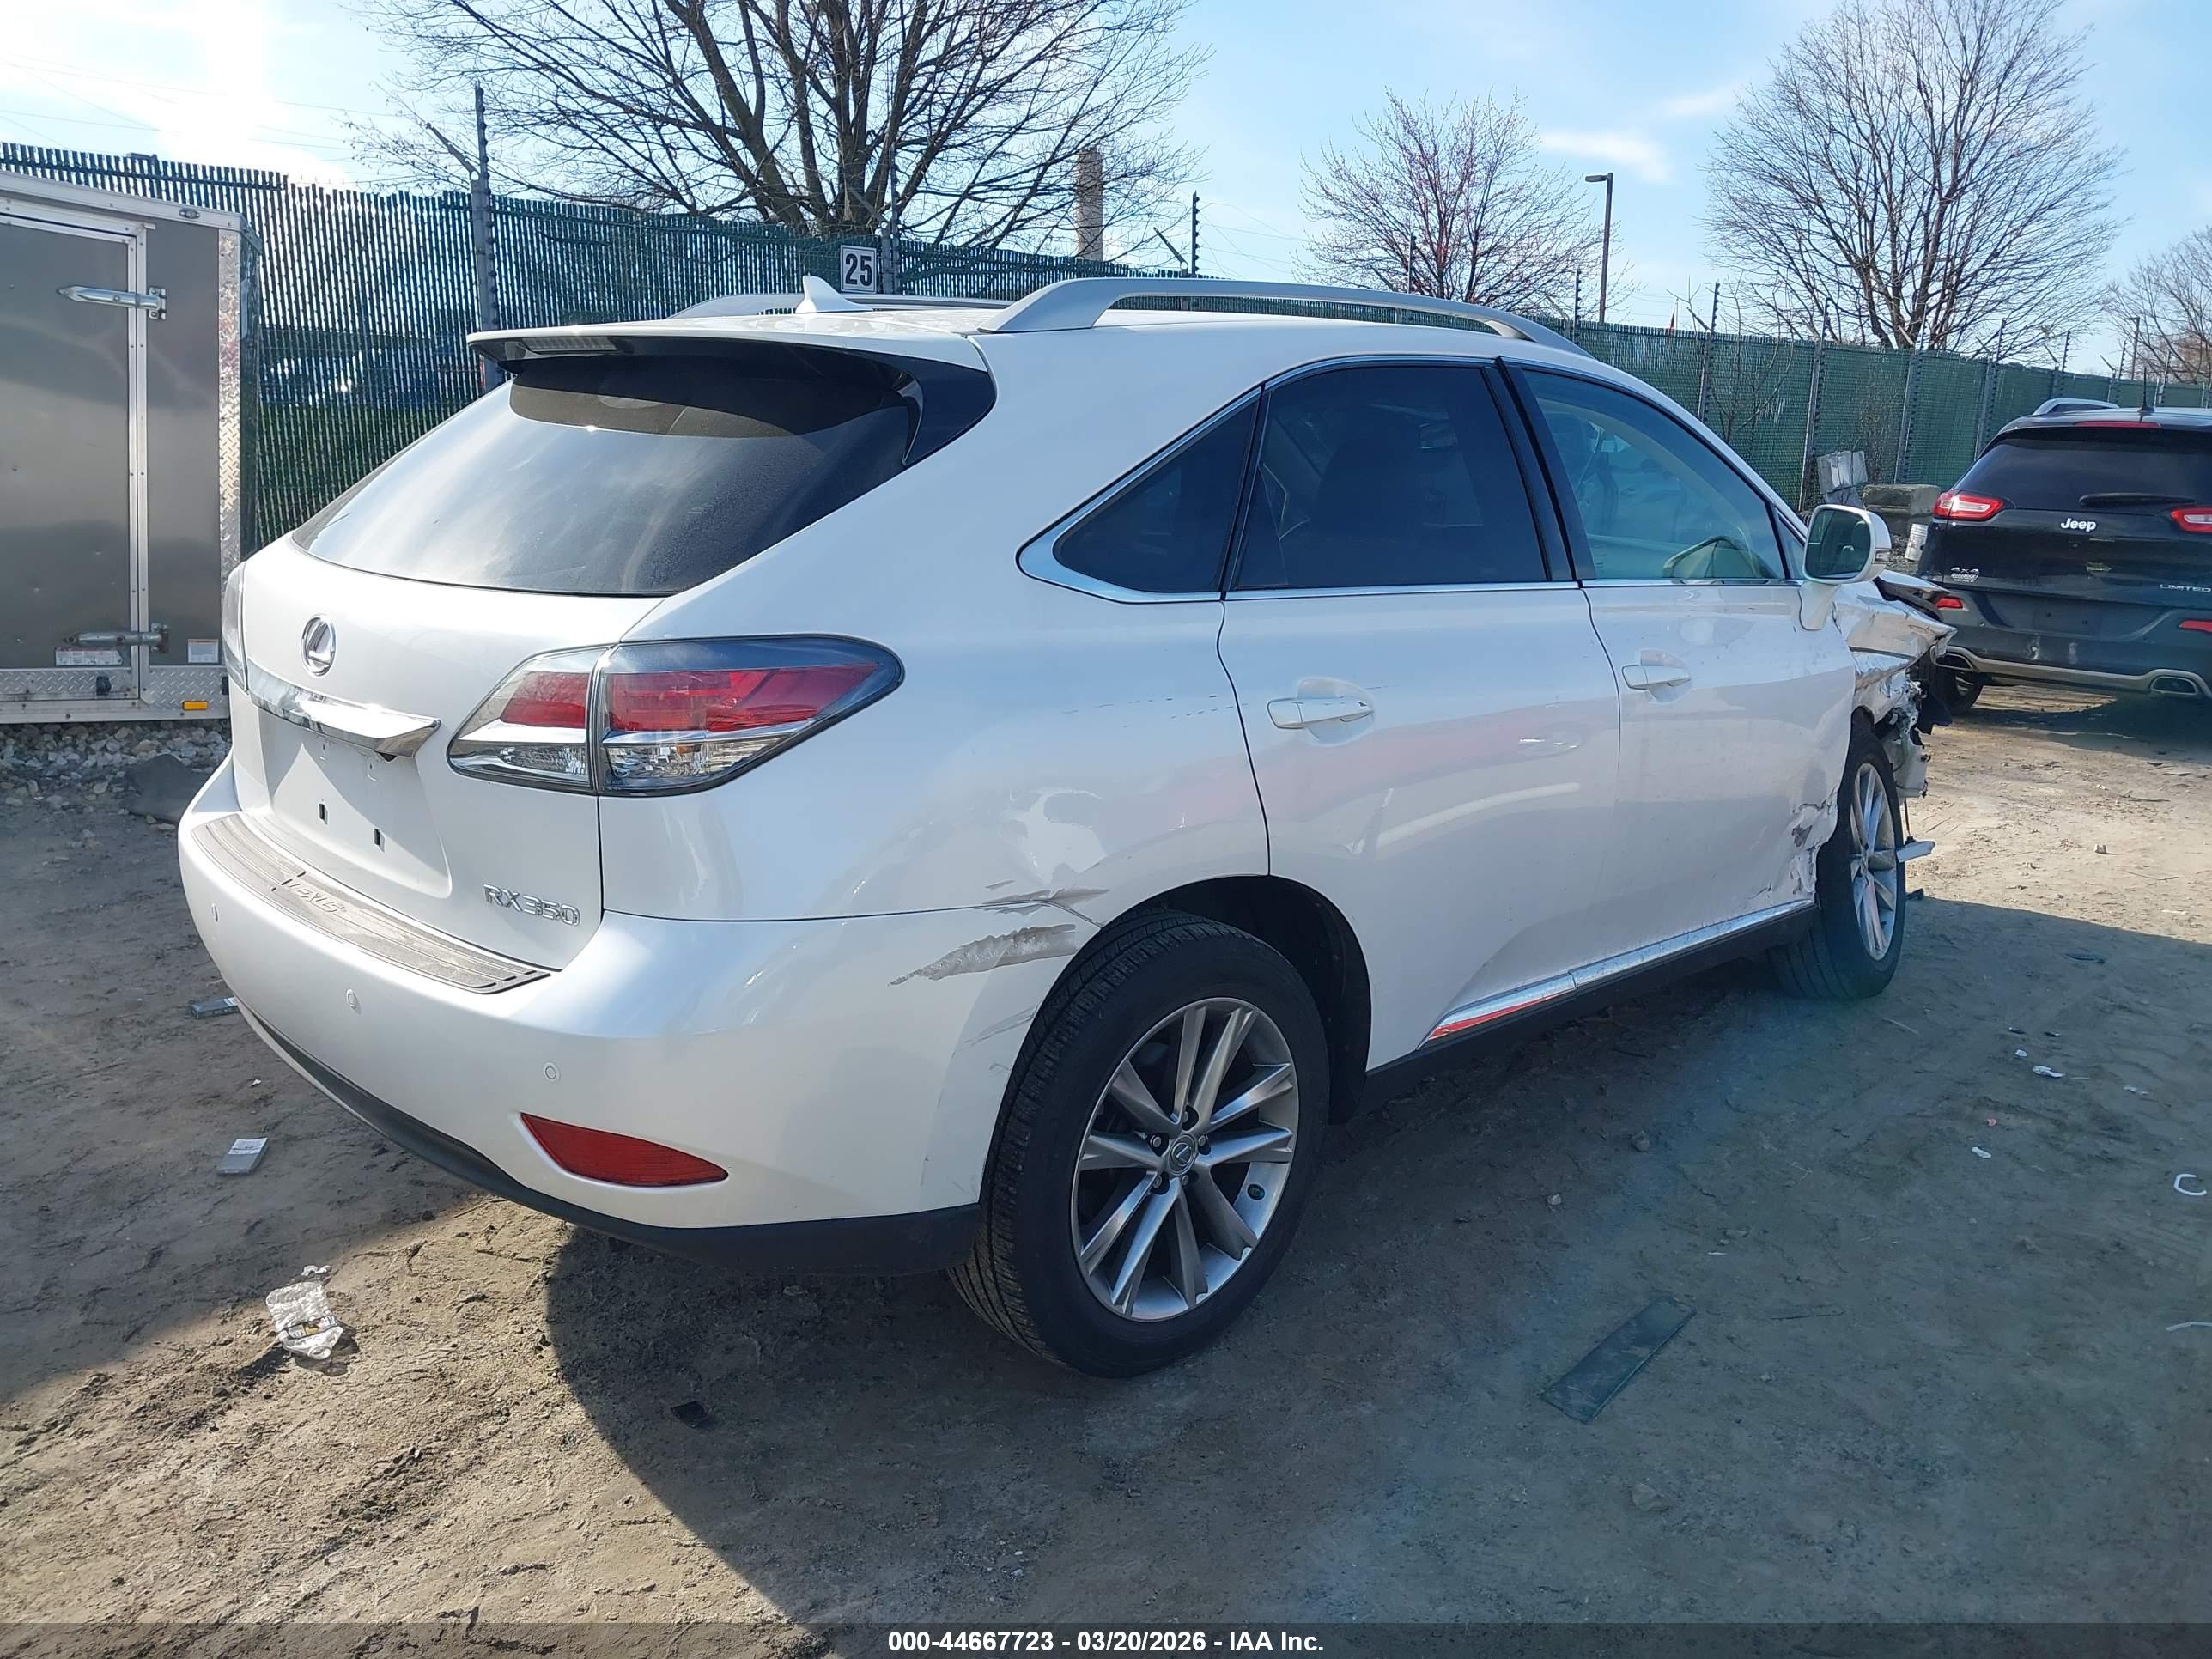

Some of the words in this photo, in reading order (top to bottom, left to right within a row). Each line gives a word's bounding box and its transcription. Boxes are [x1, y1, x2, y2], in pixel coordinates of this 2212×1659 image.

[845, 253, 872, 286] 25
[2061, 517, 2097, 532] Jeep
[2160, 584, 2212, 592] LIMITED
[289, 882, 346, 914] LEXUS
